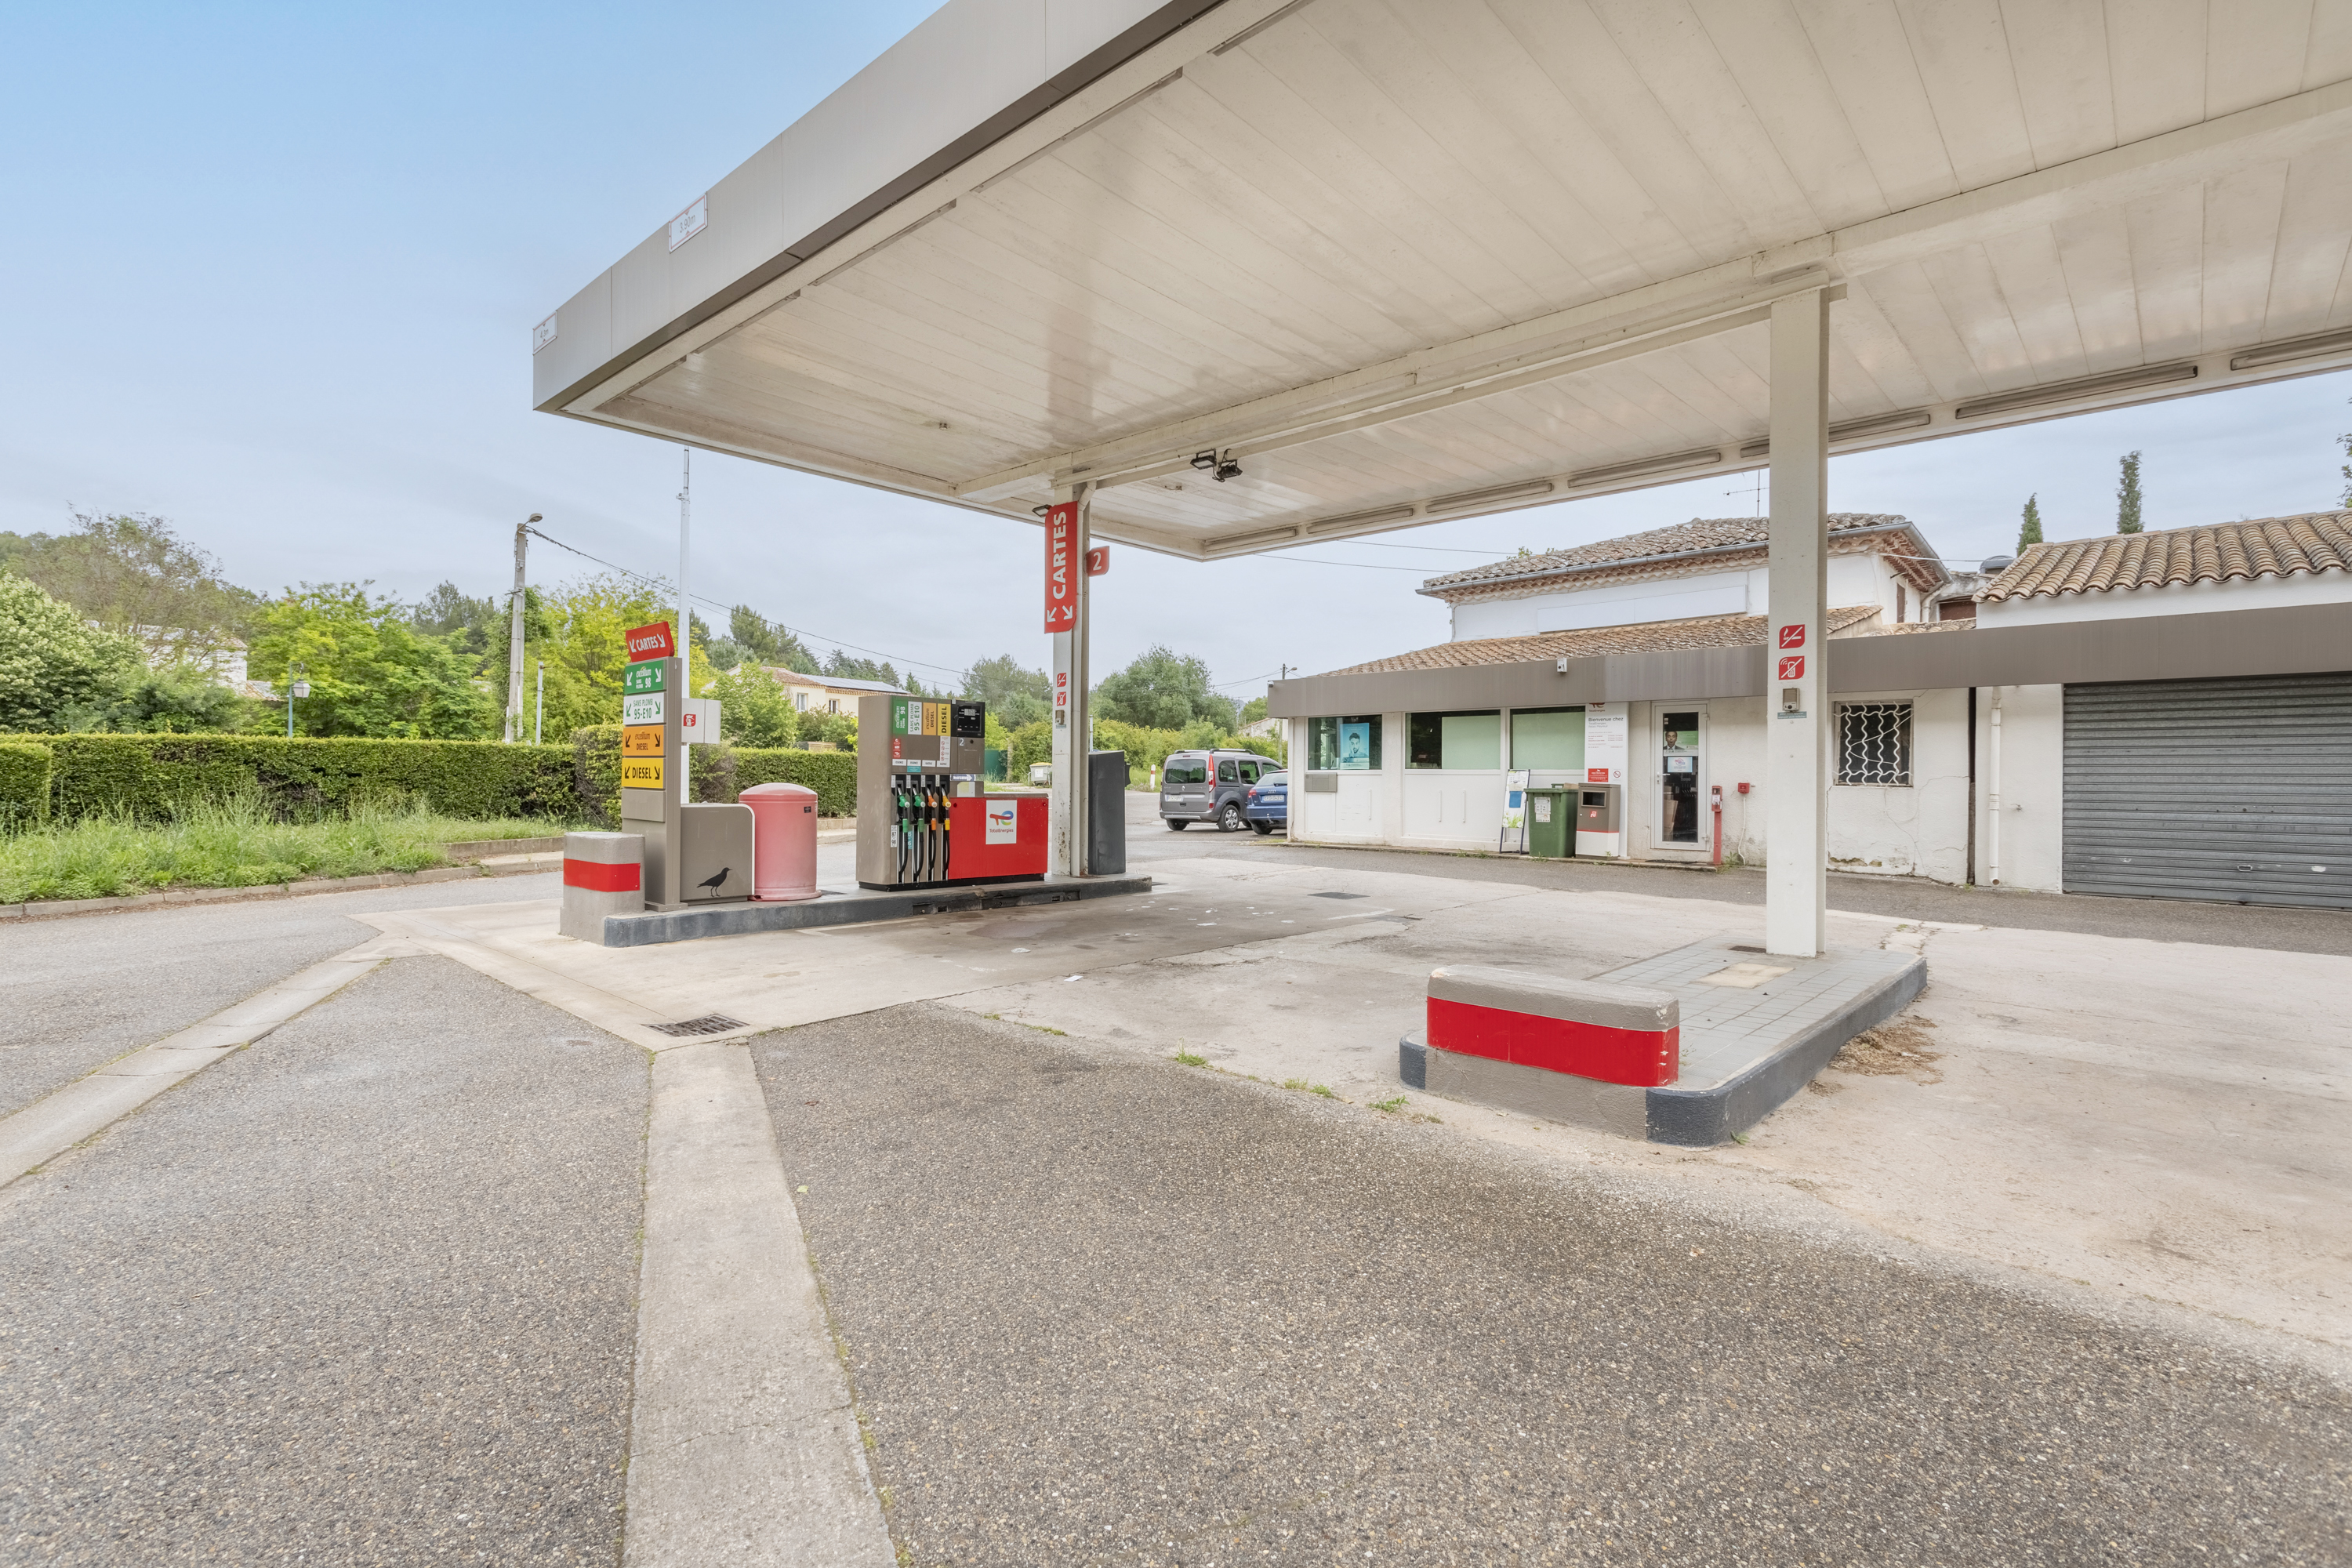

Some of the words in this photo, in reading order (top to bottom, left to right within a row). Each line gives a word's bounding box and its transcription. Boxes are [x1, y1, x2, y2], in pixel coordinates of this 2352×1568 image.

[679, 214, 696, 234] 3.90m
[1053, 510, 1067, 600] CARTES
[1093, 551, 1102, 571] 2
[636, 635, 659, 652] CARTES
[645, 677, 652, 688] 98
[642, 698, 653, 706] PLOMB
[633, 707, 652, 720] 95-E10
[959, 738, 964, 746] 2
[632, 767, 652, 779] DIESEL
